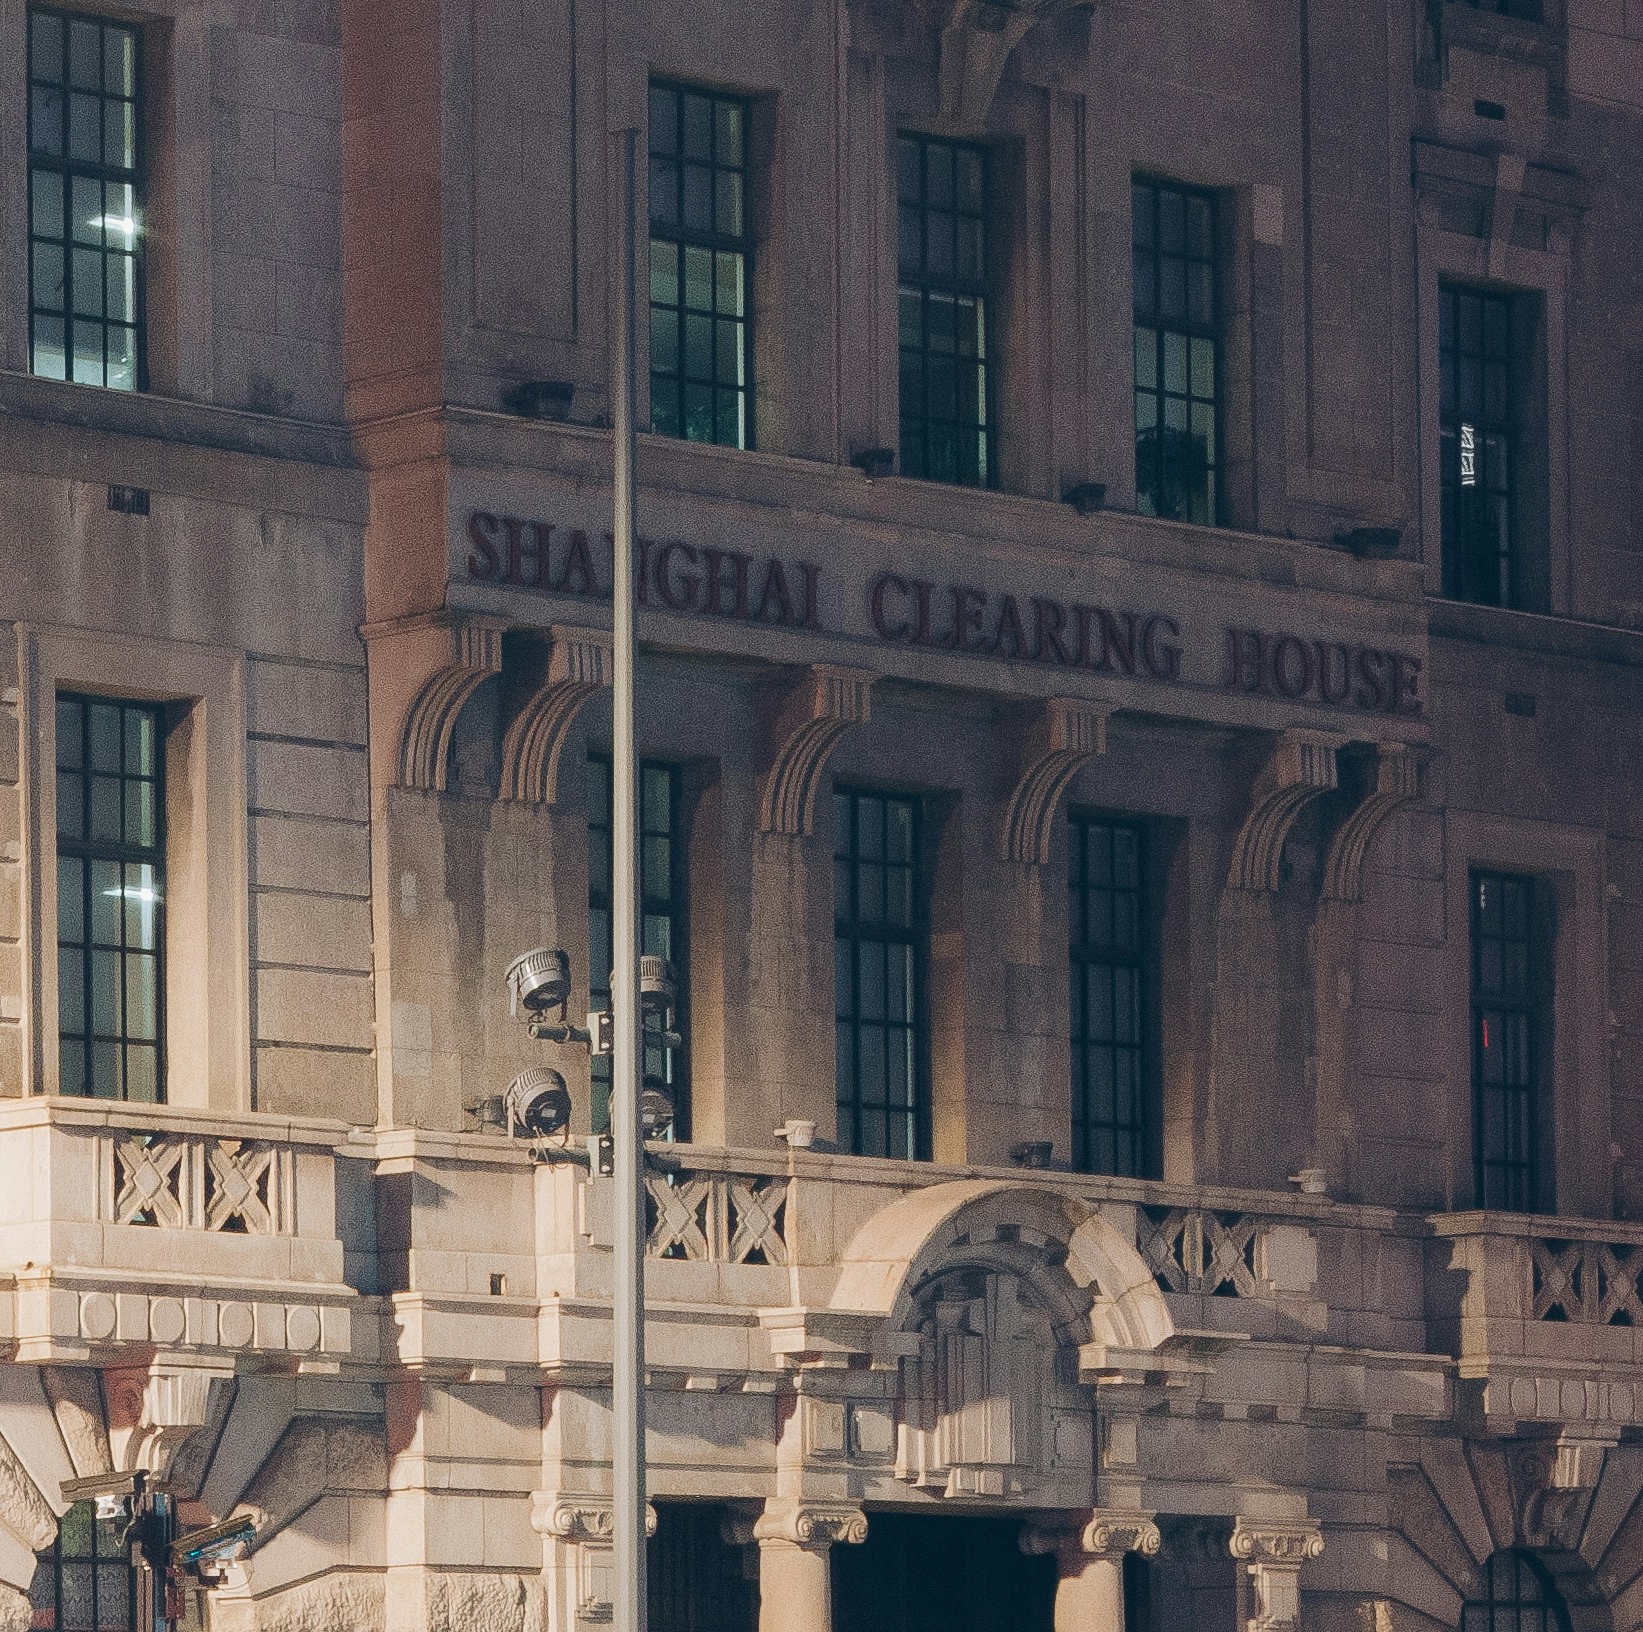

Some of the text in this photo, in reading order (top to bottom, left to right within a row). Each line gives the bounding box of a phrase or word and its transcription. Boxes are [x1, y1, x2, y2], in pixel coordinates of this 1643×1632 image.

[468, 511, 1421, 714] SHANGHAI CLEARING HOUSE
